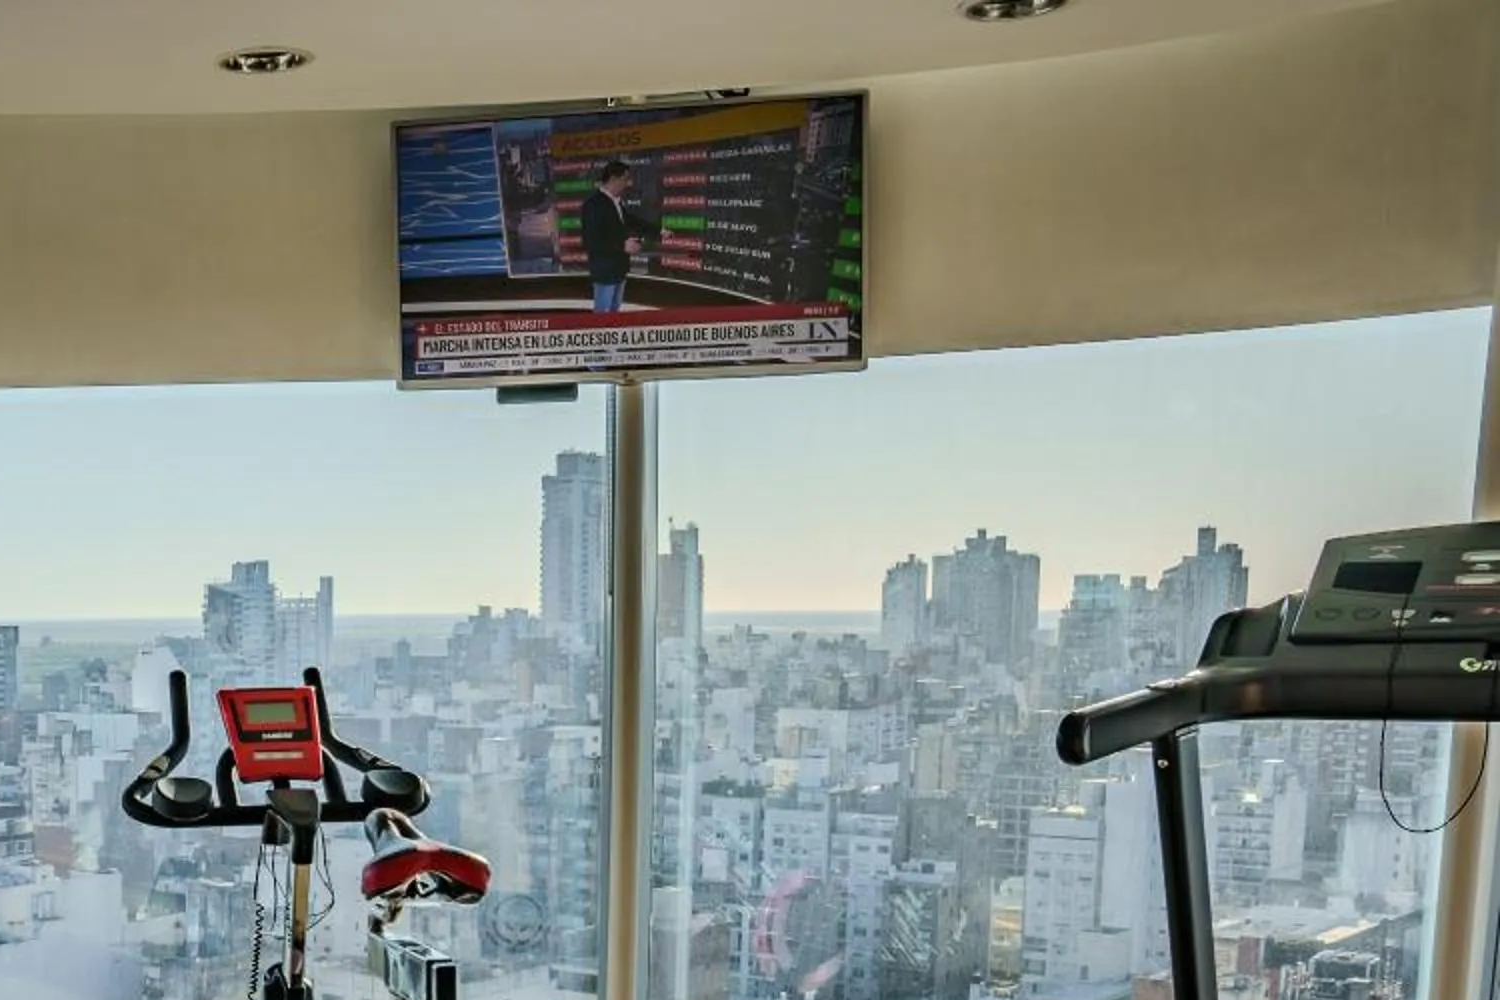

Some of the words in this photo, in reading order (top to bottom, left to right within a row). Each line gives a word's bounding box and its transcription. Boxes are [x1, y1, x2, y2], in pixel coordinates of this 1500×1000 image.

[447, 322, 483, 333] ESTADO
[423, 339, 470, 355] MARCHA
[471, 337, 522, 351] INTENSA
[524, 335, 539, 349] EN
[542, 334, 564, 349] LOS
[566, 331, 619, 347] ACCESOS
[621, 331, 629, 345] A
[631, 330, 646, 345] LA
[647, 328, 691, 343] CIUDAD
[693, 327, 709, 342] DE
[711, 325, 759, 341] BUENOS
[761, 323, 796, 338] AIRES
